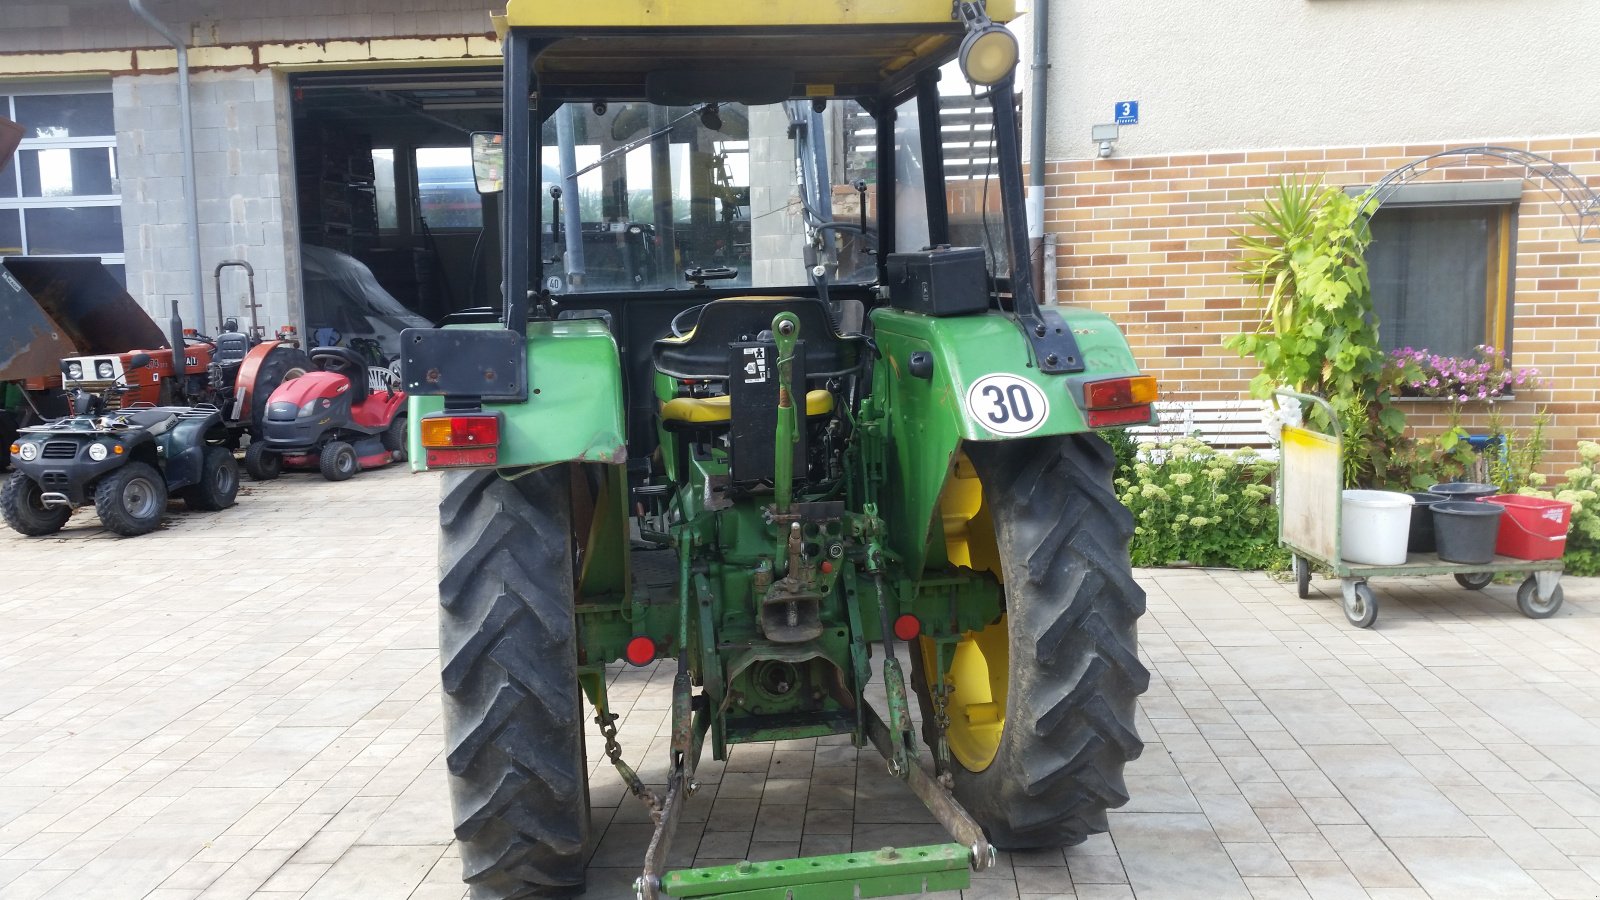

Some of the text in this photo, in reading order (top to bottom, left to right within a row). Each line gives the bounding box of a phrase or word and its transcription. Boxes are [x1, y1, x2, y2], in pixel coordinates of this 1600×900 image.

[1122, 103, 1131, 116] 3
[550, 279, 559, 288] 40
[982, 384, 1034, 424] 30
